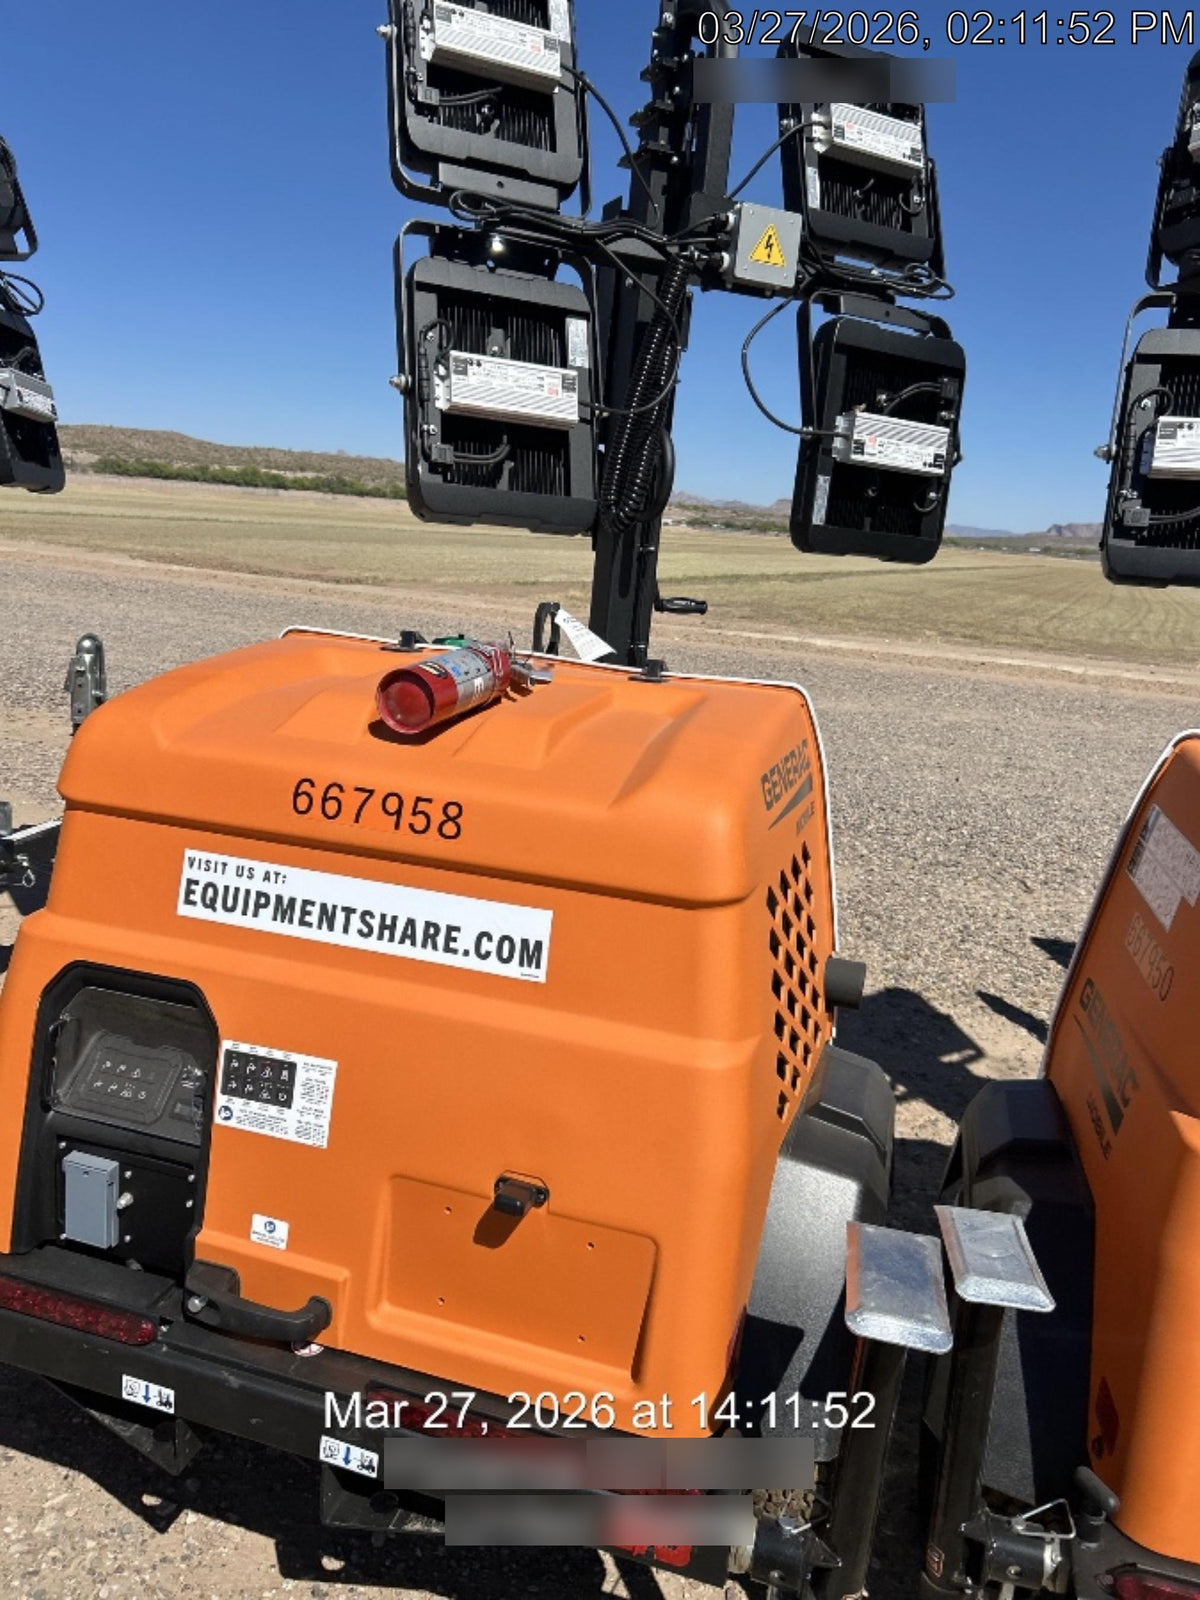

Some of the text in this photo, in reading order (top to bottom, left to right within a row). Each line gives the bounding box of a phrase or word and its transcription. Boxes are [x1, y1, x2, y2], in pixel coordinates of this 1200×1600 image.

[292, 778, 464, 839] 667958
[187, 856, 287, 885] VISIT US AT:
[182, 878, 544, 971] EQUIPMENTSHARE.COM
